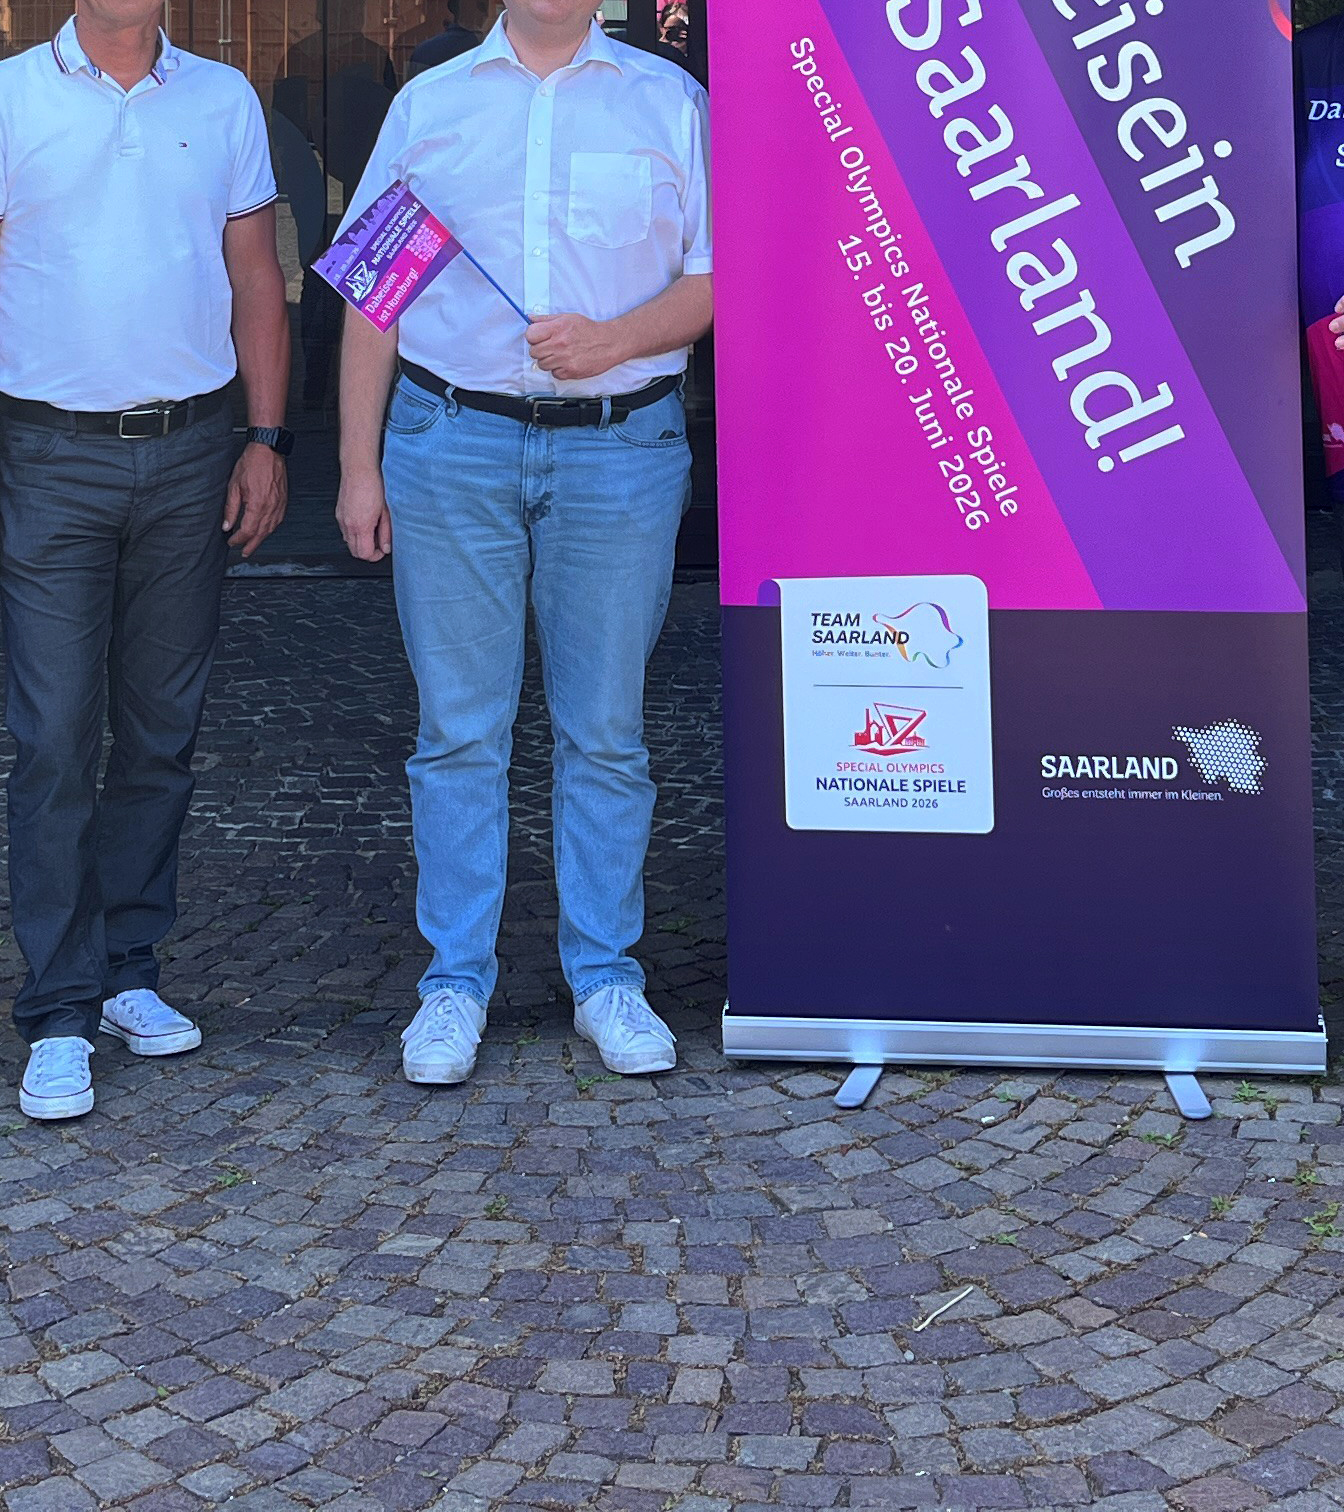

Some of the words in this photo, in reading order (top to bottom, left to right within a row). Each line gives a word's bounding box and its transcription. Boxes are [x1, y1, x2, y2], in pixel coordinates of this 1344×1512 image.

[371, 224, 402, 265] NATIONALE
[399, 202, 422, 228] SPIELE
[789, 36, 853, 142] Special
[839, 145, 910, 278] Olympics
[900, 281, 975, 420] Nationale
[966, 425, 1019, 517] Spiele
[365, 272, 399, 314] Dabeisein
[377, 308, 391, 323] ist
[387, 267, 419, 312] Homburg!
[837, 234, 873, 281] 15.
[861, 282, 894, 332] bis
[884, 335, 919, 385] 20.
[908, 387, 954, 450] Juni
[937, 454, 991, 531] 2026
[811, 612, 861, 627] TEAM
[811, 630, 910, 645] SAARLAND
[836, 761, 883, 773] SPECIAL
[886, 763, 945, 774] OLYMPICS
[1041, 754, 1179, 780] SAARLAND
[816, 777, 910, 792] NATIONALE
[912, 779, 967, 793] SPIELE
[1042, 786, 1080, 800] Großes
[1081, 789, 1126, 799] entsteht
[1127, 788, 1162, 800] immer
[1165, 789, 1179, 800] im
[1181, 789, 1224, 801] Kleinen.
[844, 796, 909, 808] SAARLAND
[911, 798, 939, 809] 2026
